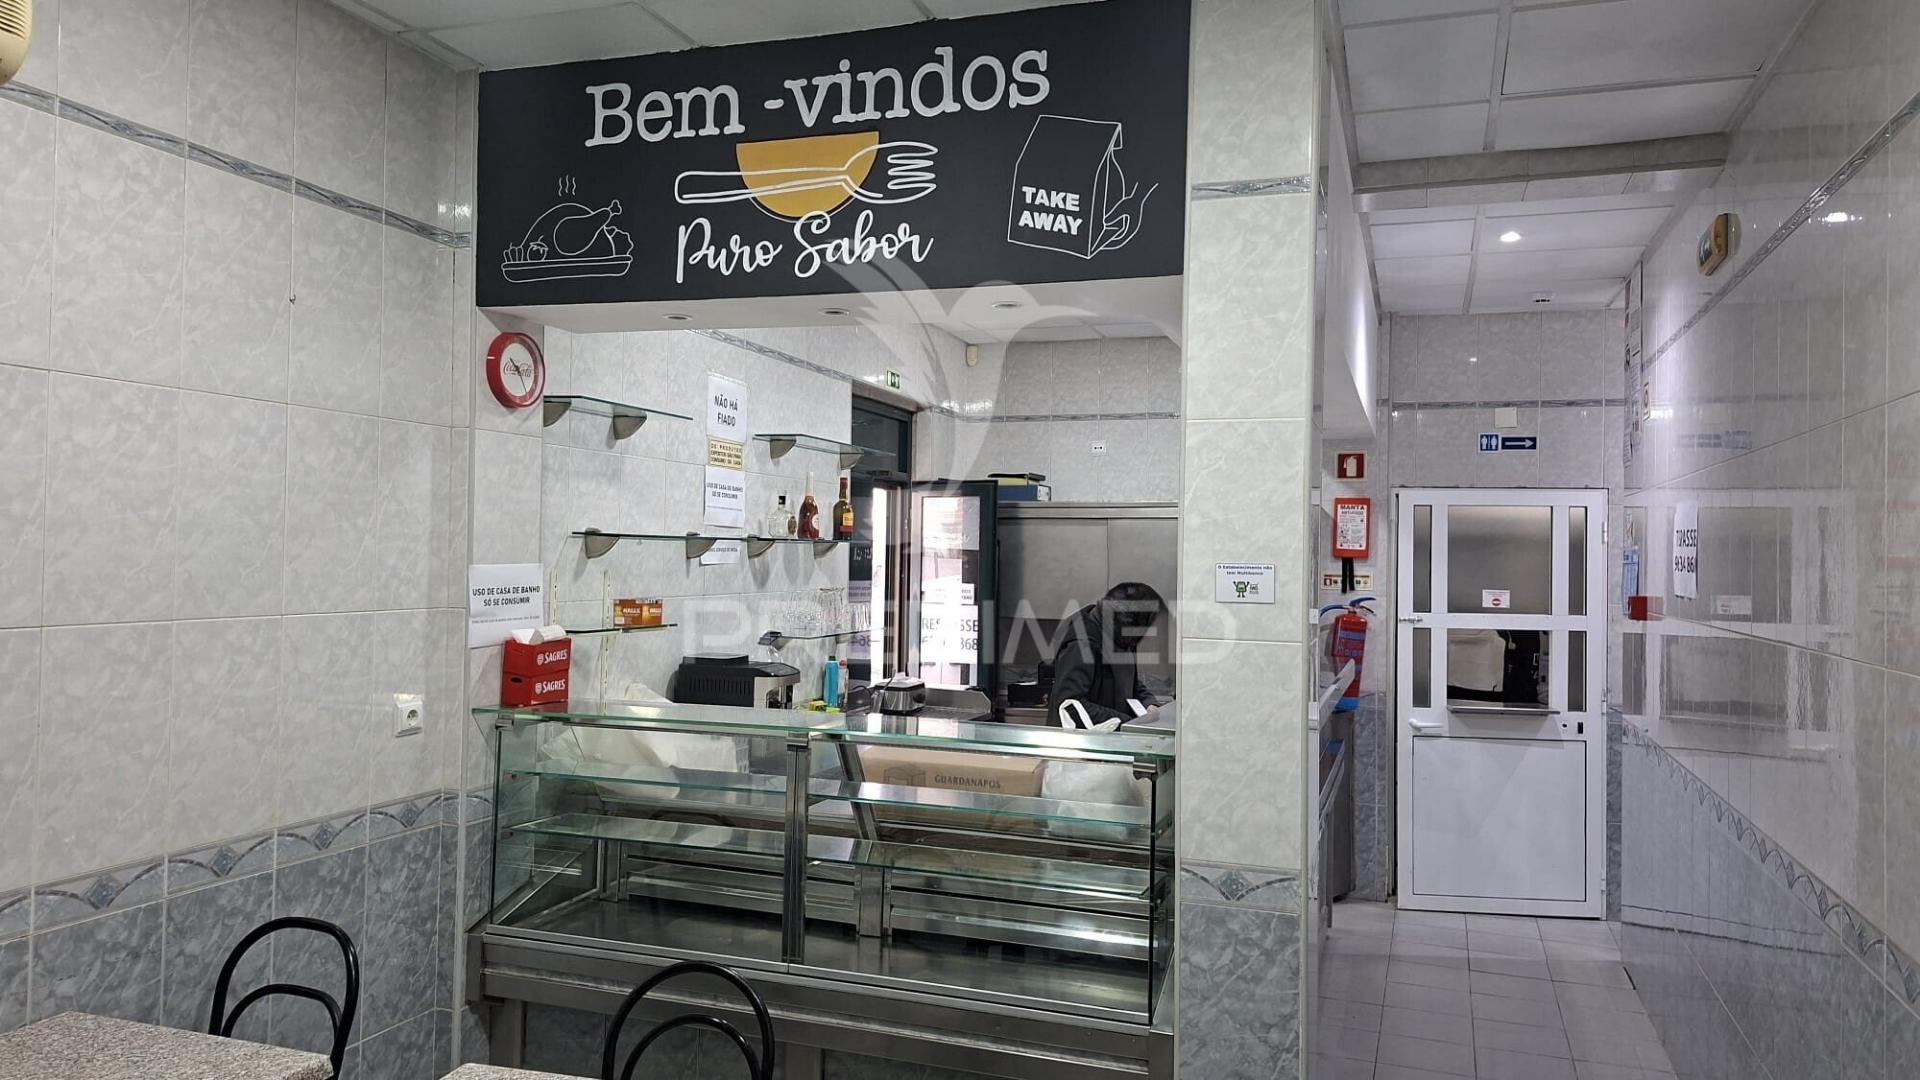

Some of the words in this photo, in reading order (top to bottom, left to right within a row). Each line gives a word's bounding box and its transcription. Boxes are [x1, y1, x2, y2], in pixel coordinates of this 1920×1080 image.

[585, 82, 746, 147] Bem
[1022, 186, 1080, 212] TAKE
[1018, 210, 1083, 235] AWAY
[676, 217, 783, 284] Puro
[793, 210, 934, 278] Sabor
[714, 394, 728, 409] NÃO
[729, 398, 738, 411] HÁ
[718, 412, 736, 427] FIADO
[472, 588, 486, 596] USO
[496, 586, 510, 595] CASA
[521, 586, 540, 594] BANHO
[501, 597, 530, 606] CONSUMIR
[544, 649, 568, 664] SAGRES
[542, 678, 566, 694] SAGRES
[934, 774, 1001, 788] GUARDANAPOS
